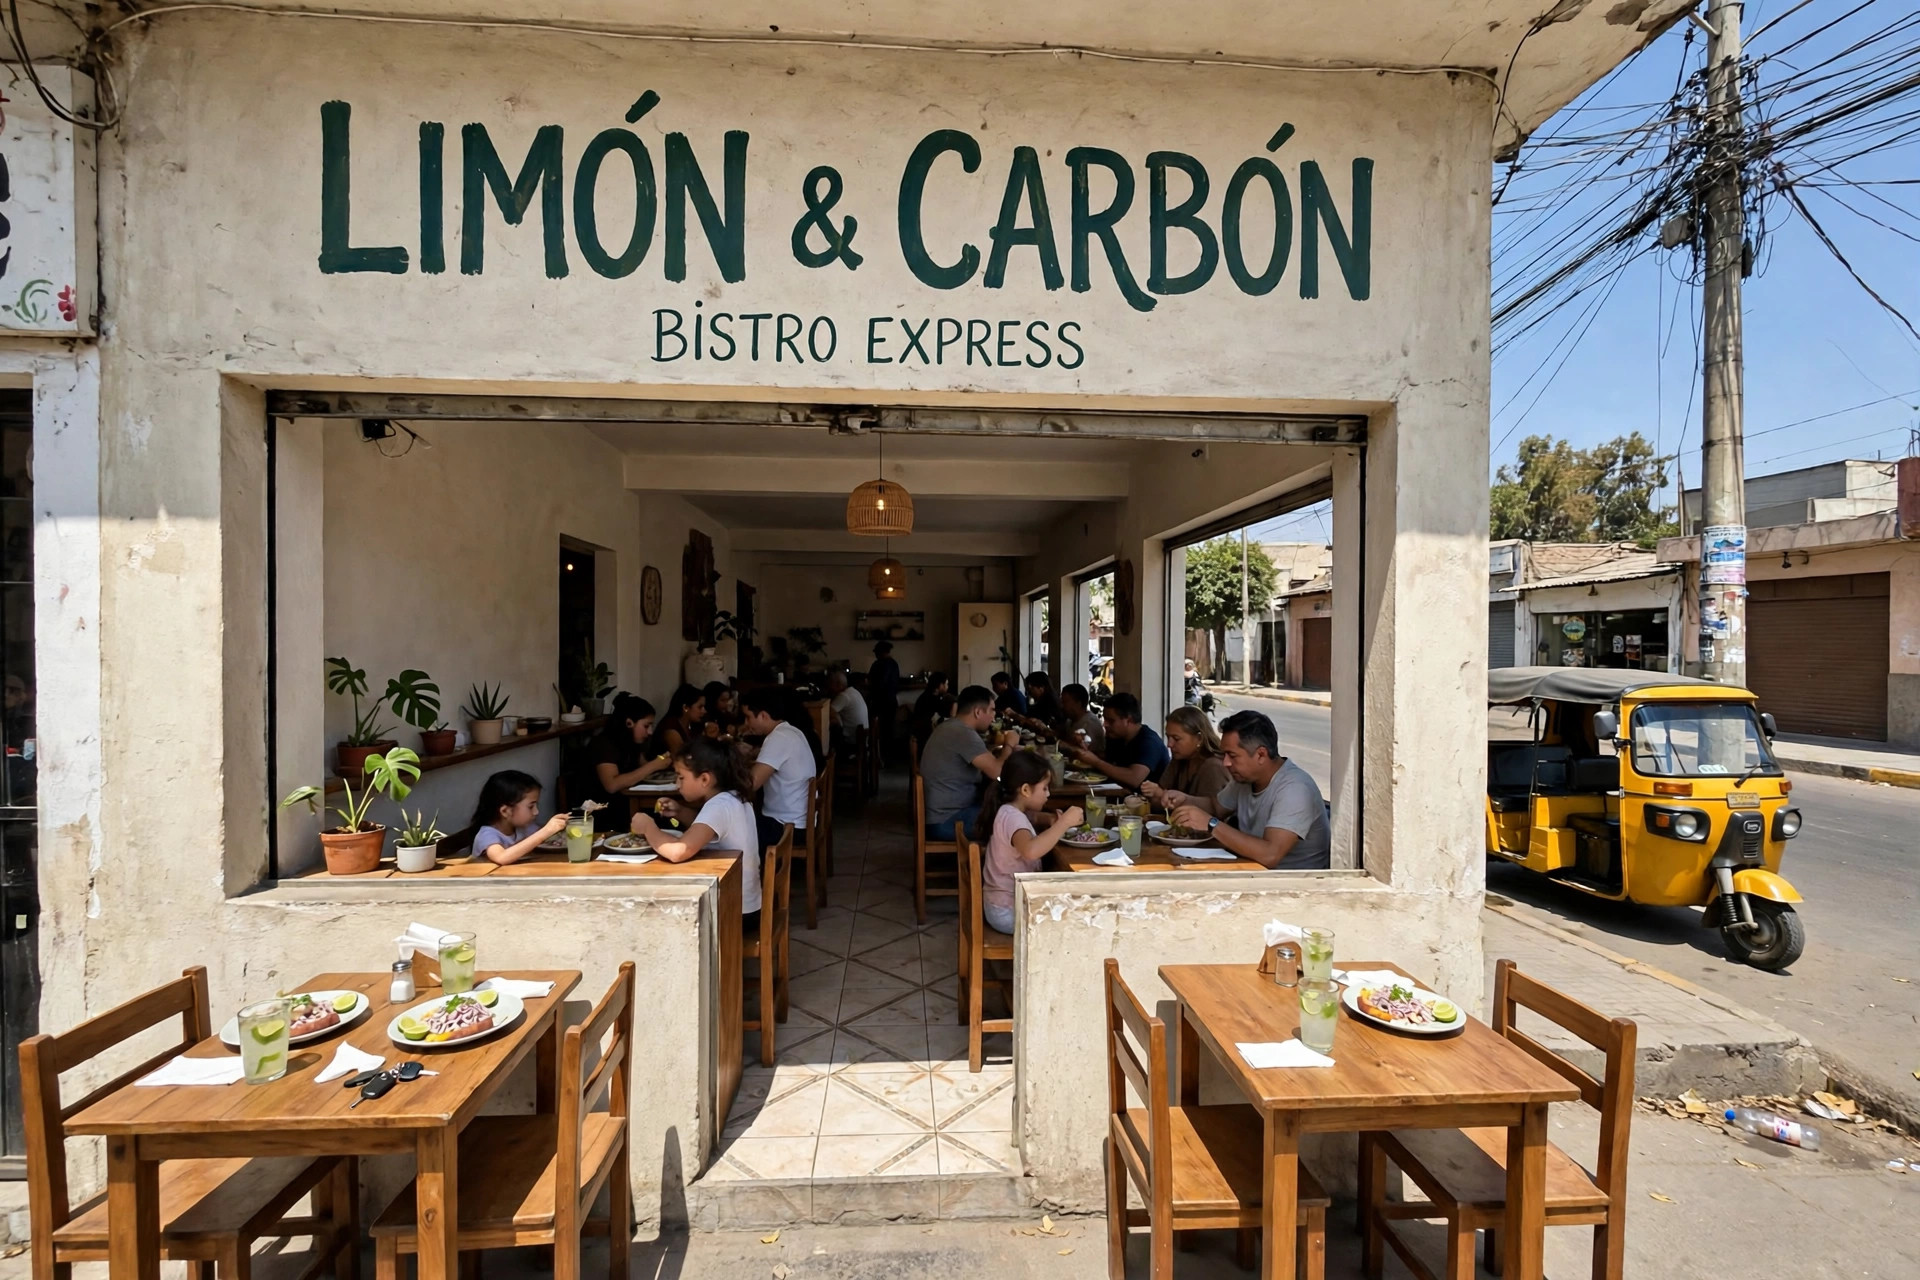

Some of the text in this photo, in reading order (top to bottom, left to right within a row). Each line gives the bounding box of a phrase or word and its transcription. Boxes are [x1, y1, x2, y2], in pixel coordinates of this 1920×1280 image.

[318, 90, 1375, 313] LIMÓN & CARBÓN
[867, 316, 1085, 370] EXPRESS
